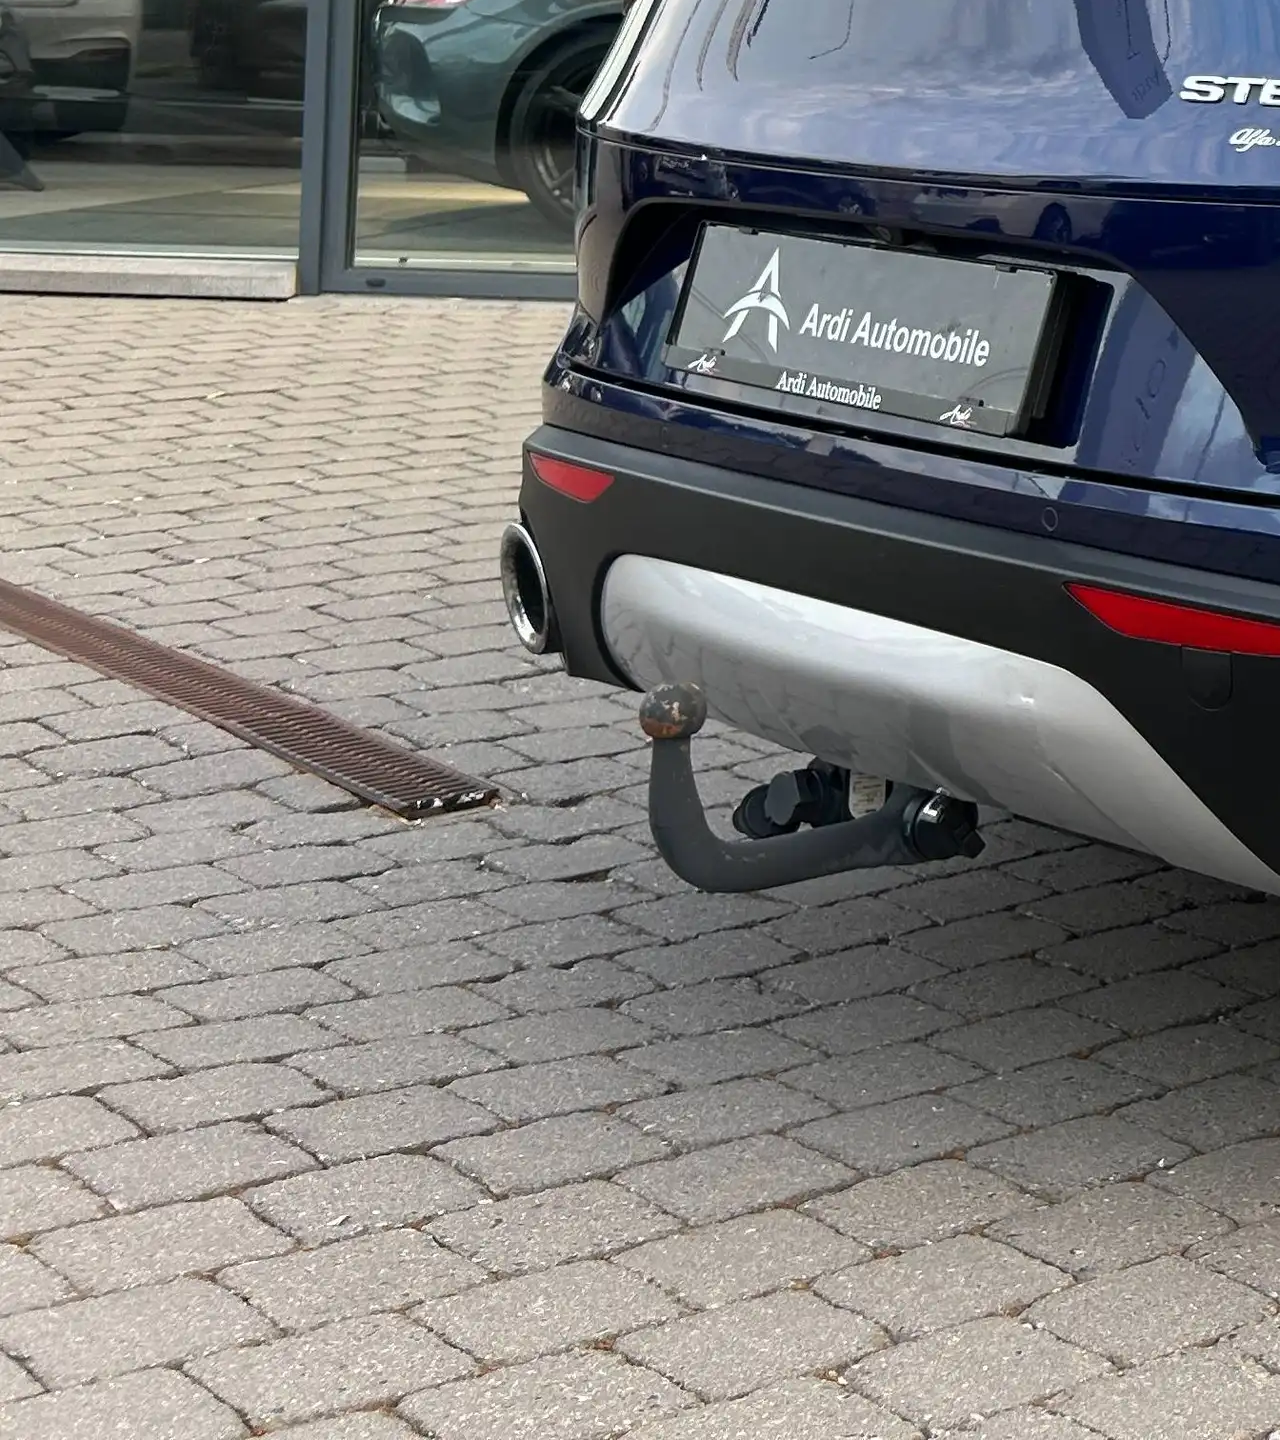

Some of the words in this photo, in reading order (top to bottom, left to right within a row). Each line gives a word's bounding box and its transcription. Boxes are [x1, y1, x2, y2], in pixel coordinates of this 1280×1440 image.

[1229, 127, 1275, 152] Alfa
[800, 304, 854, 342] Ardi
[851, 311, 990, 367] Automobile
[775, 371, 806, 395] Ardi
[805, 376, 882, 410] Automobile
